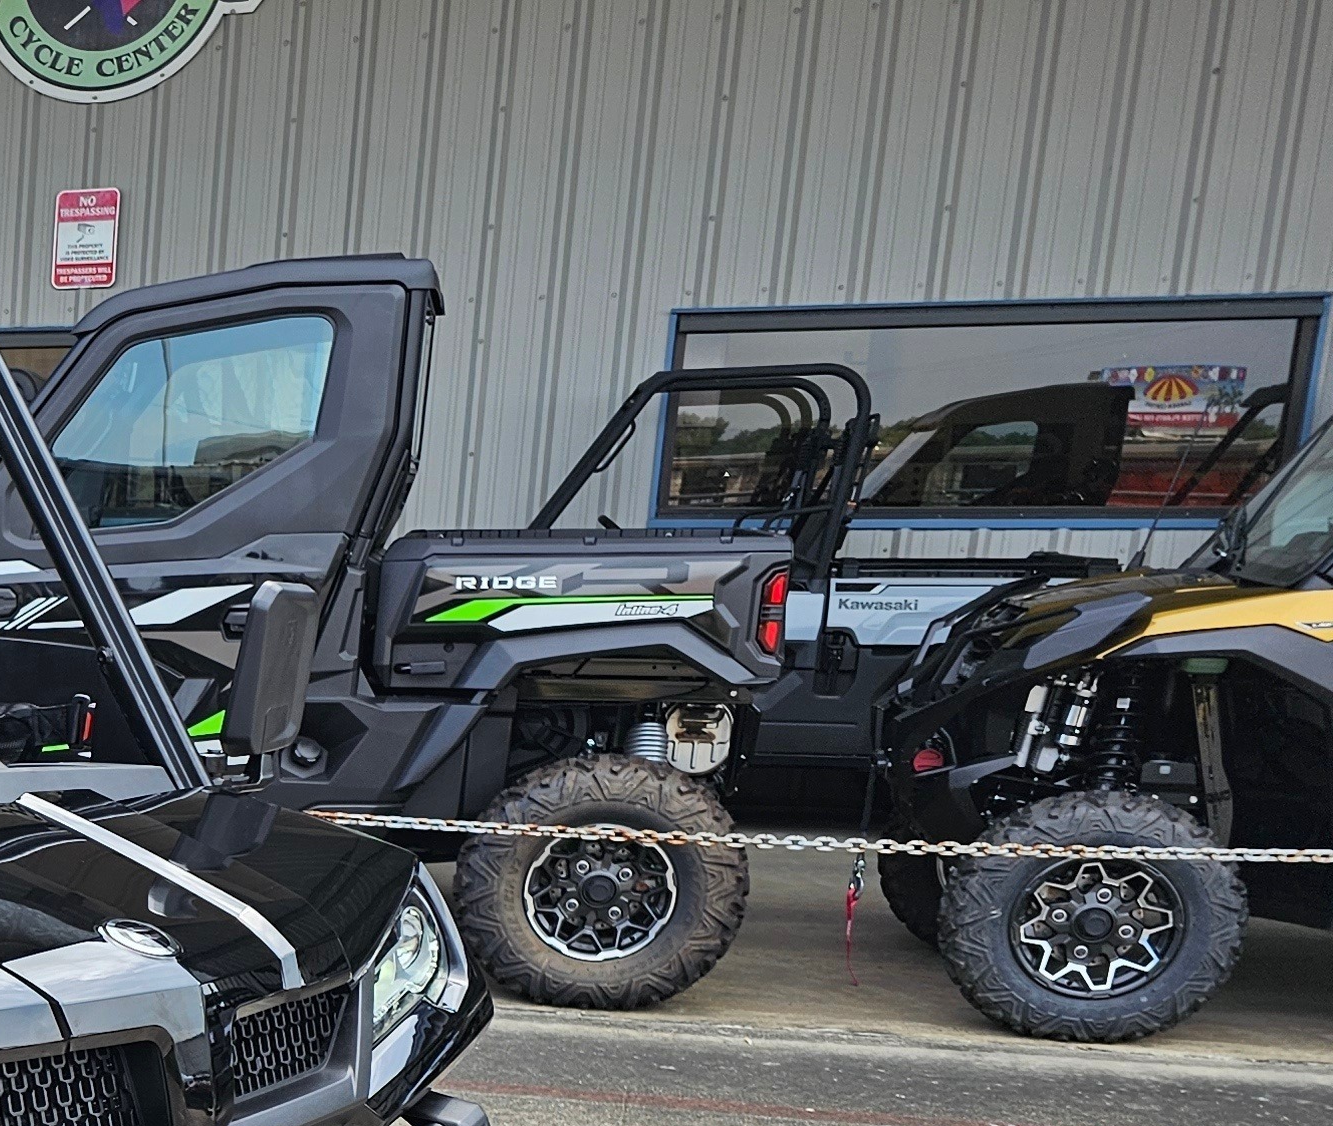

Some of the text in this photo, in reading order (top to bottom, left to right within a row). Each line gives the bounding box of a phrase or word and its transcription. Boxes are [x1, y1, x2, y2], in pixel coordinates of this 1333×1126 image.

[9, 3, 200, 78] CYCLE CENTER
[79, 195, 97, 207] NO
[59, 206, 115, 218] TRESPASSING
[456, 575, 557, 590] RIDGE
[838, 598, 918, 611] Kawasaki
